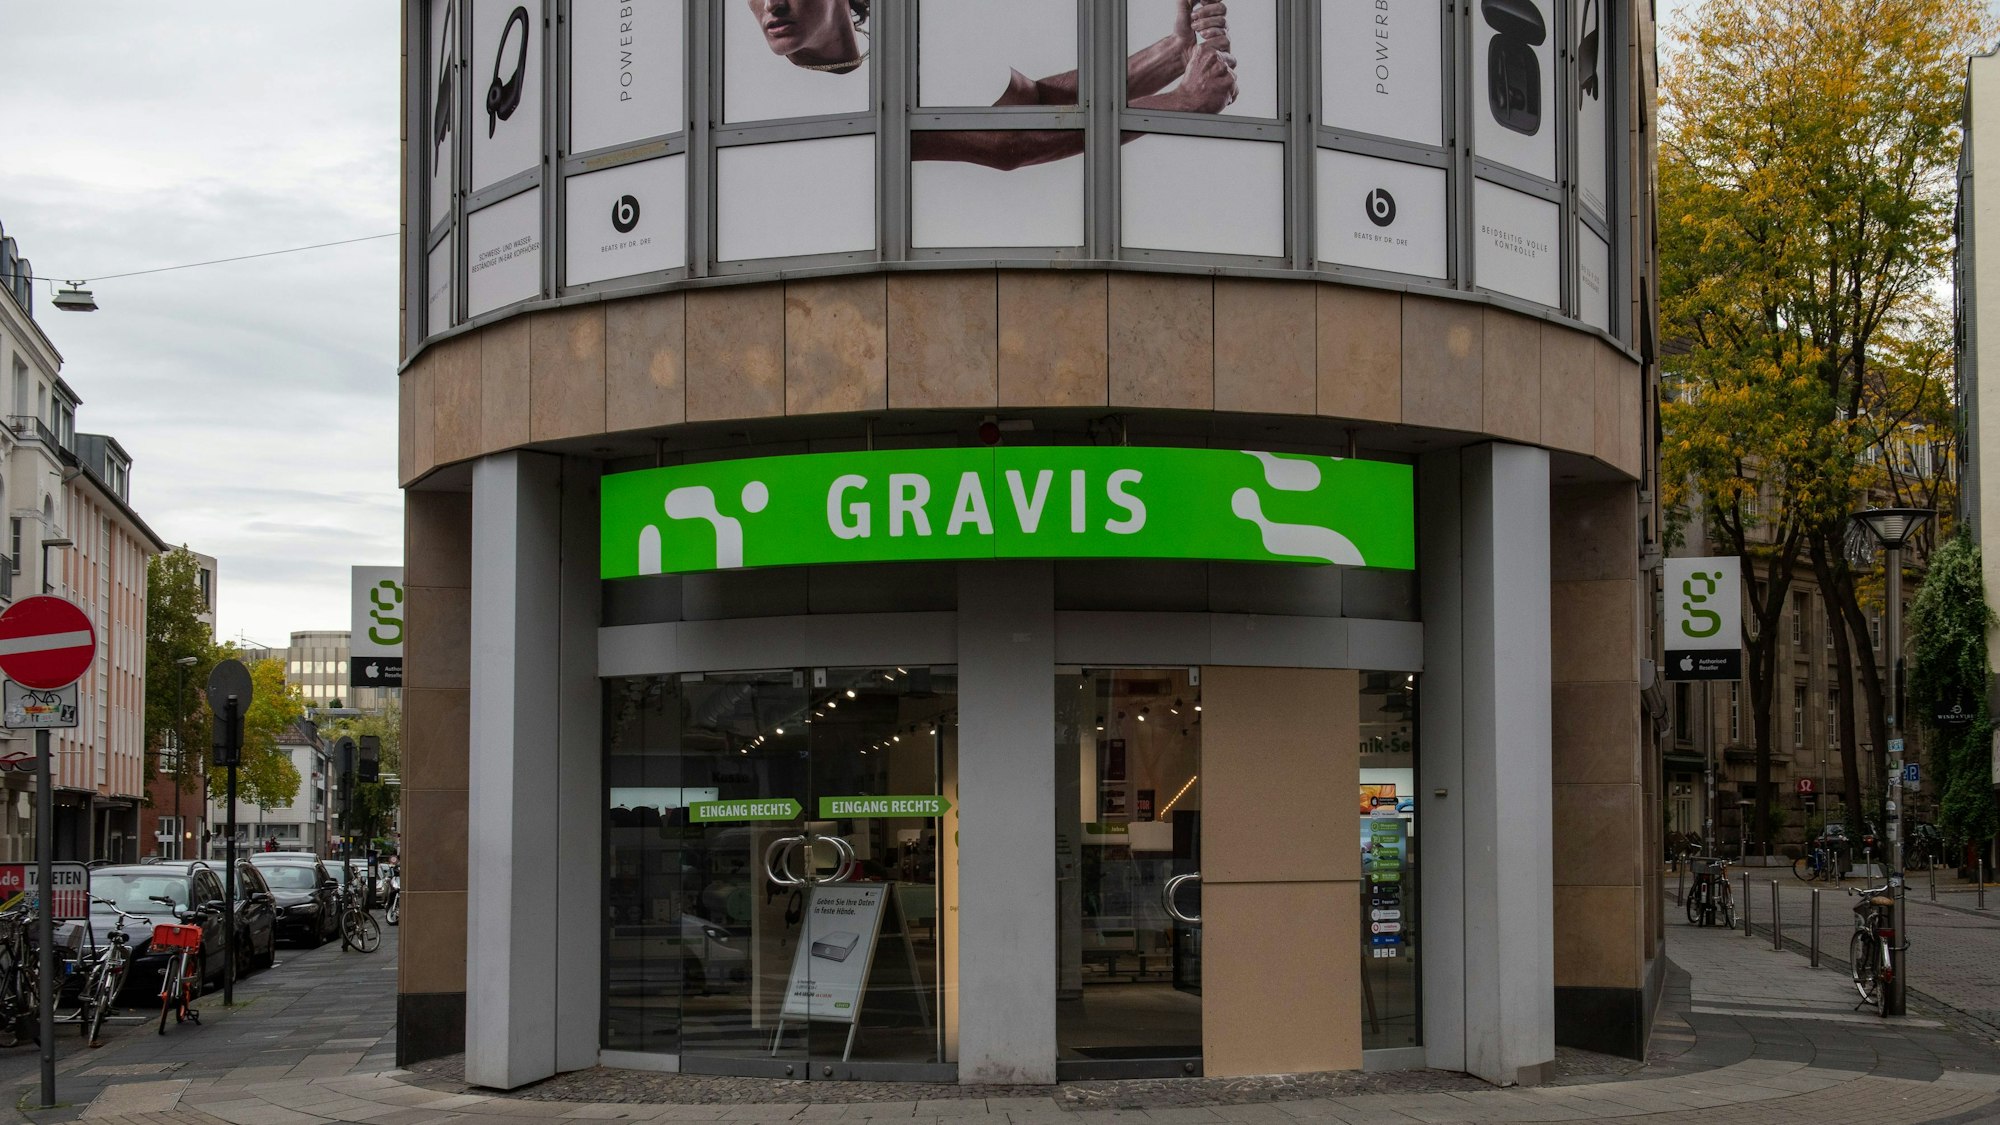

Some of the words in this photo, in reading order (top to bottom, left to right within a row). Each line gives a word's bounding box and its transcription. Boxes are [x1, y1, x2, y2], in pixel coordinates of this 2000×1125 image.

[601, 243, 618, 253] BEATS
[619, 242, 627, 250] BY
[640, 237, 652, 246] DRE
[1353, 232, 1373, 241] BEATS
[1396, 238, 1408, 246] DRE
[1481, 225, 1523, 245] BEIDSEITIG
[1526, 240, 1548, 253] VOLLE
[502, 242, 513, 252] UND
[1495, 240, 1536, 258] KONTROLLE
[472, 257, 497, 273] BESTÄNDIGE
[826, 468, 1148, 540] GRAVIS
[700, 804, 748, 818] EINGANG
[750, 803, 792, 816] RECHTS
[831, 800, 888, 814] EINGANG
[891, 799, 940, 813] RECHTS
[816, 898, 835, 906] Geben
[836, 898, 845, 906] Sie
[821, 907, 835, 915] feste
